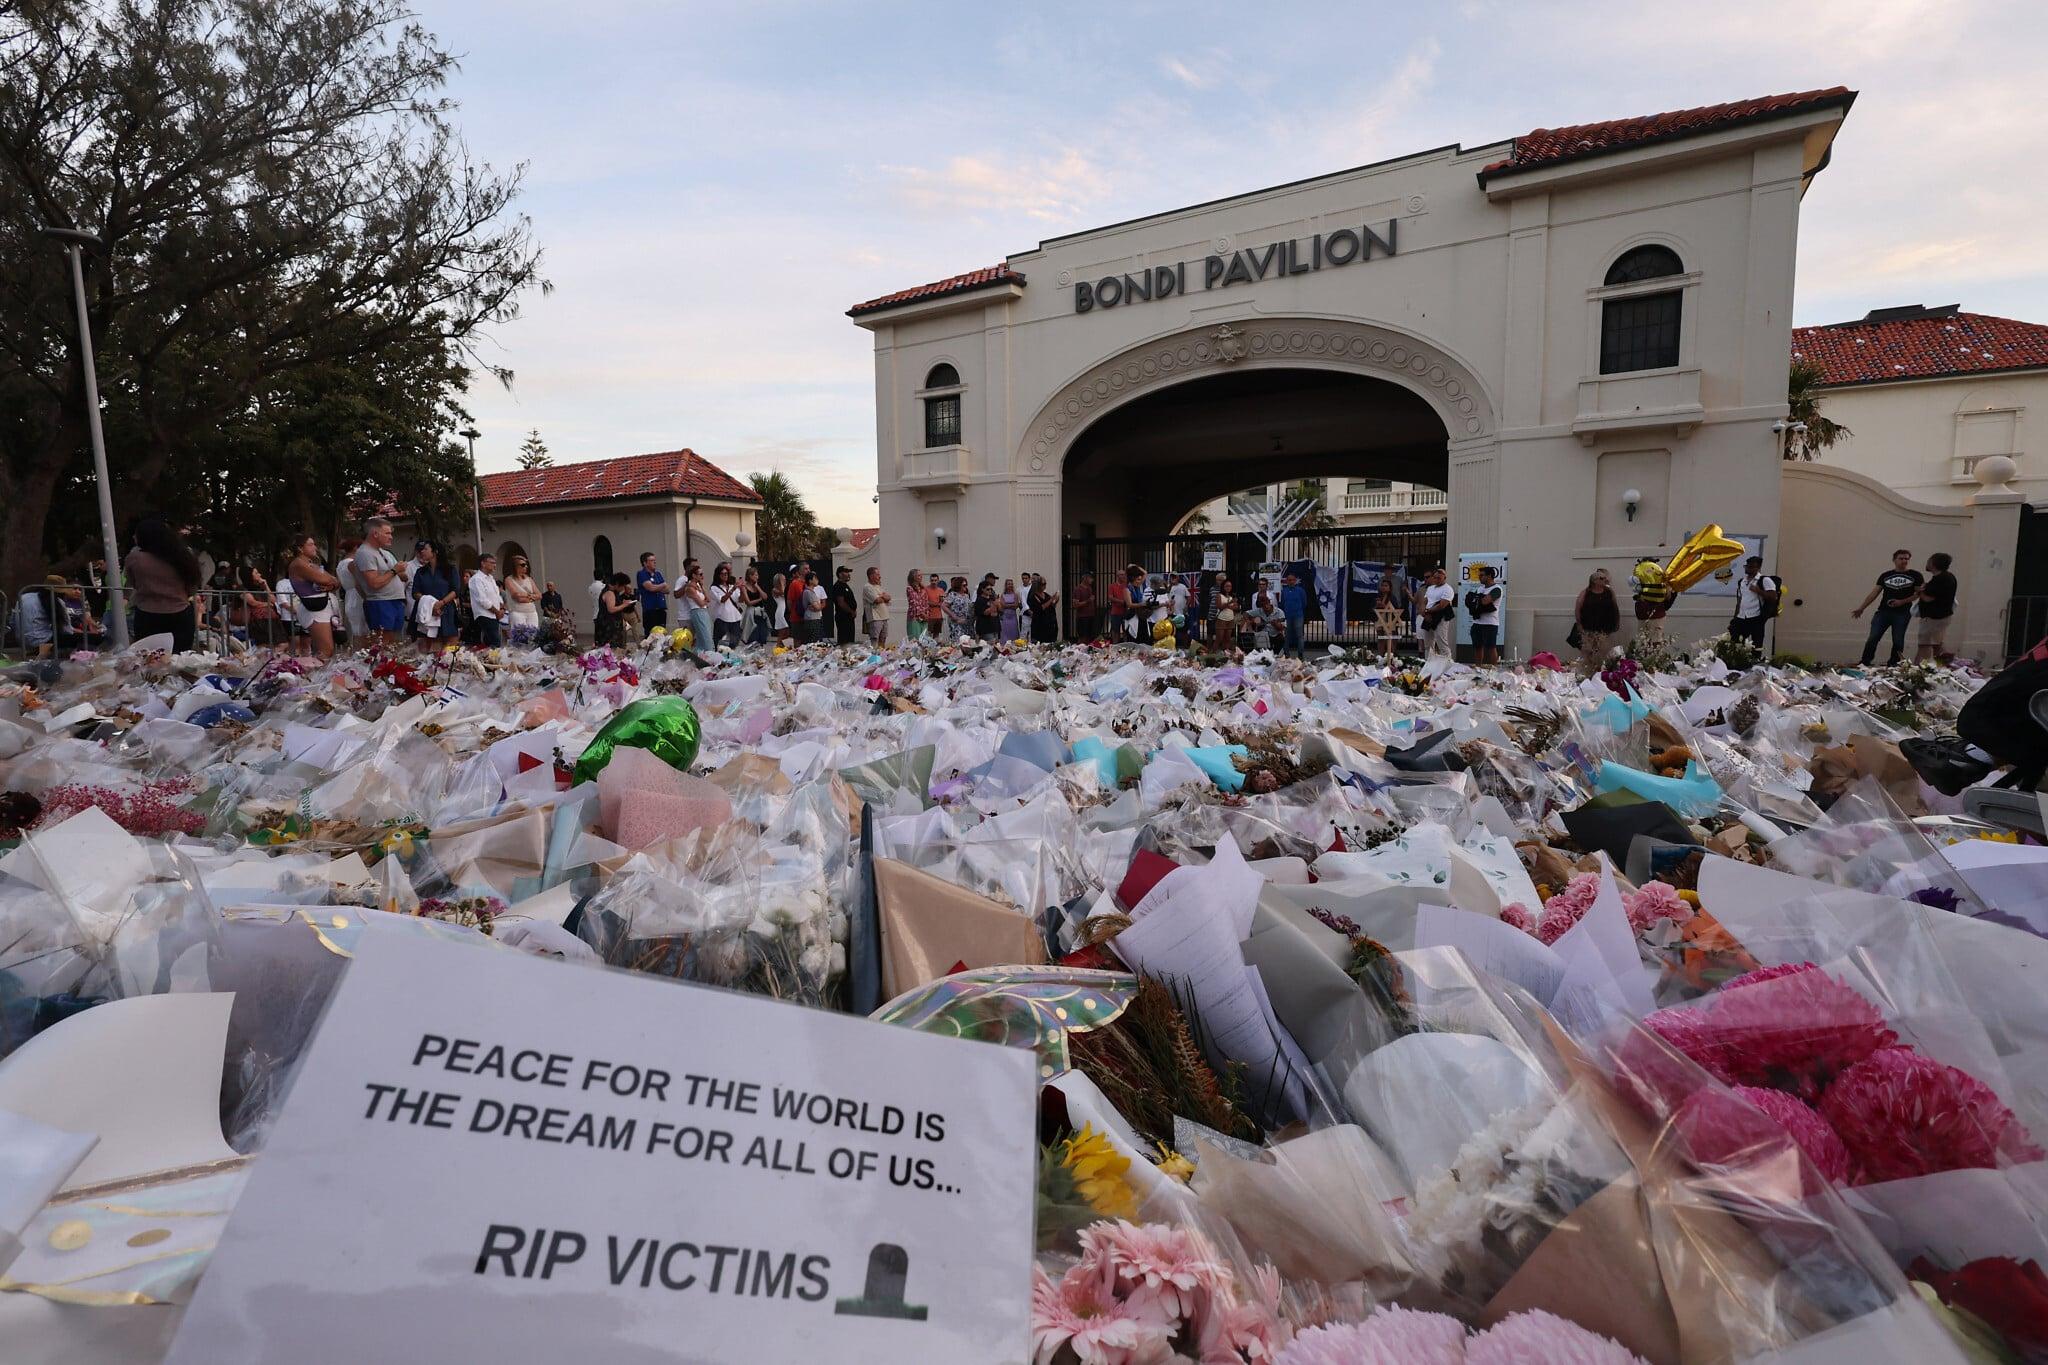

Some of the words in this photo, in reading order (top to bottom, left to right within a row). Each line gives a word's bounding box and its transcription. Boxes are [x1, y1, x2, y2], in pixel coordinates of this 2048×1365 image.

[1074, 261, 1186, 315] BONDI
[1204, 217, 1398, 291] PAVILION
[364, 1083, 462, 1129] THE
[468, 1098, 637, 1152] DREAM
[646, 1122, 734, 1164] FOR
[743, 1136, 816, 1174] ALL
[828, 1147, 879, 1181] OF
[888, 1154, 962, 1195] US...
[412, 1034, 574, 1088] PEACE
[581, 1060, 671, 1103] FOR
[685, 1074, 761, 1114] THE
[773, 1087, 905, 1136] WORLD
[914, 1111, 945, 1142] IS
[473, 1223, 588, 1280] RIP
[607, 1236, 832, 1302] VICTIMS
